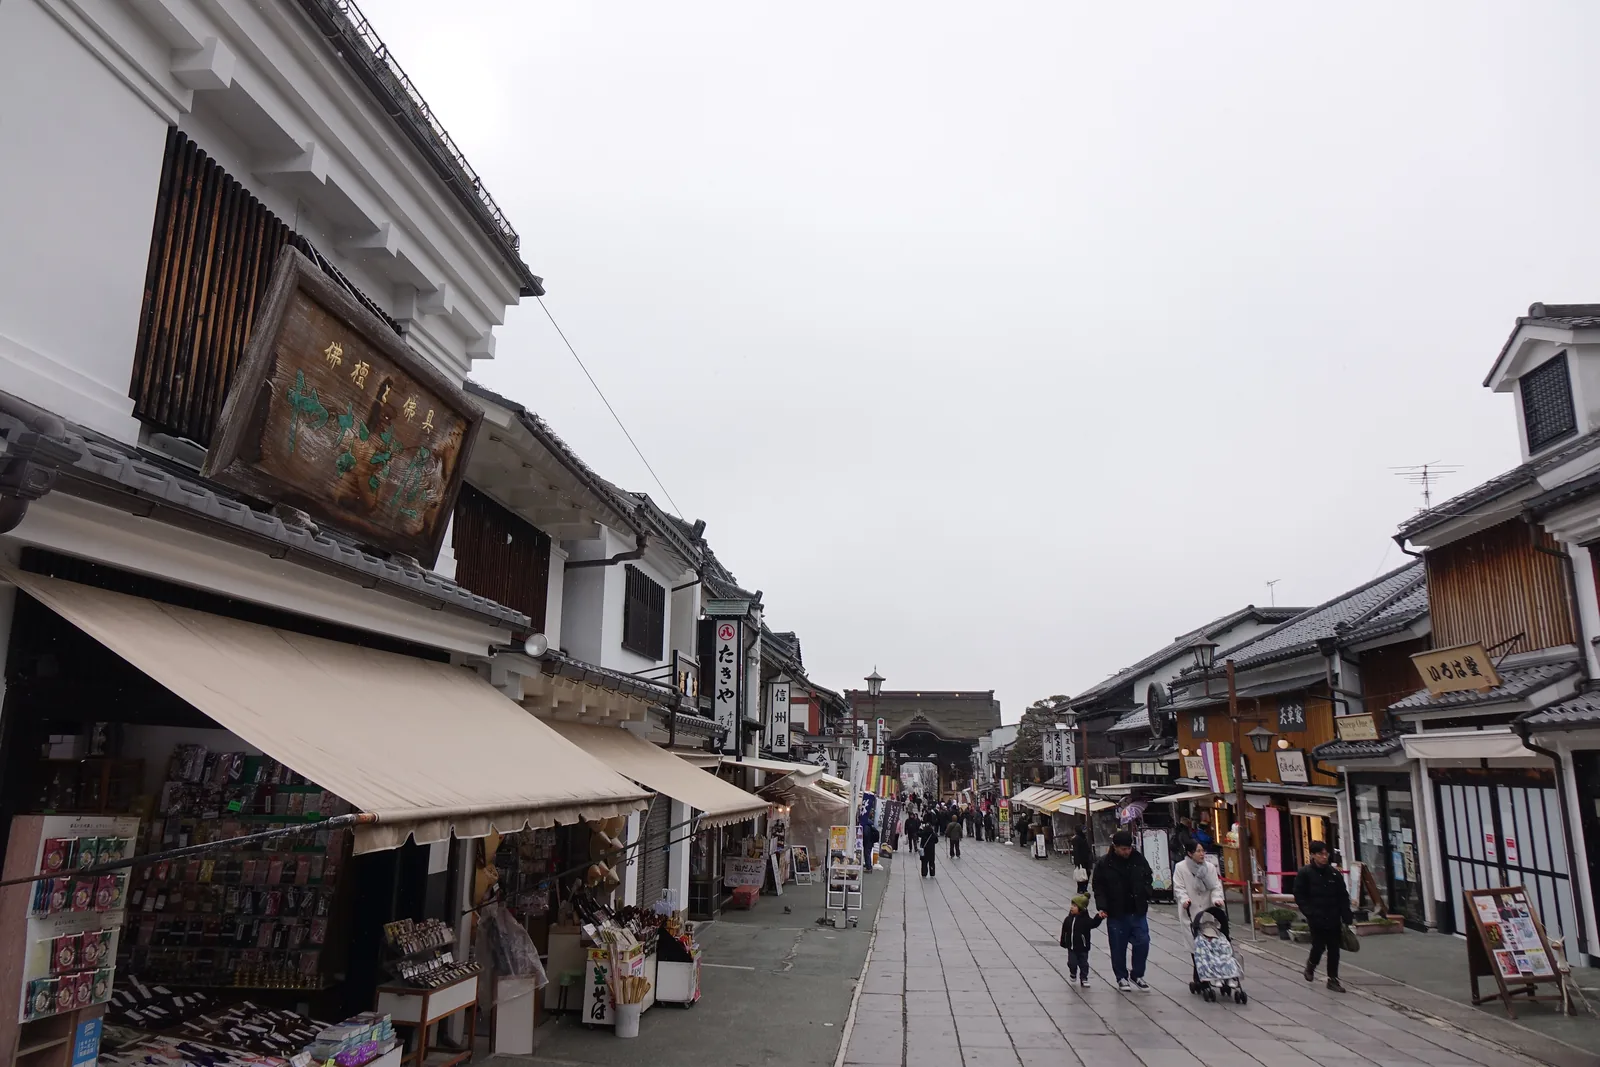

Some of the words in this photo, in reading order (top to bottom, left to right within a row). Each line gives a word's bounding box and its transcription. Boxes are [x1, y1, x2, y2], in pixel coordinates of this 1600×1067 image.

[717, 644, 735, 703] たきや
[1426, 655, 1483, 682] いろは堂
[775, 688, 787, 747] 信州屋
[591, 965, 608, 1020] 生そば
